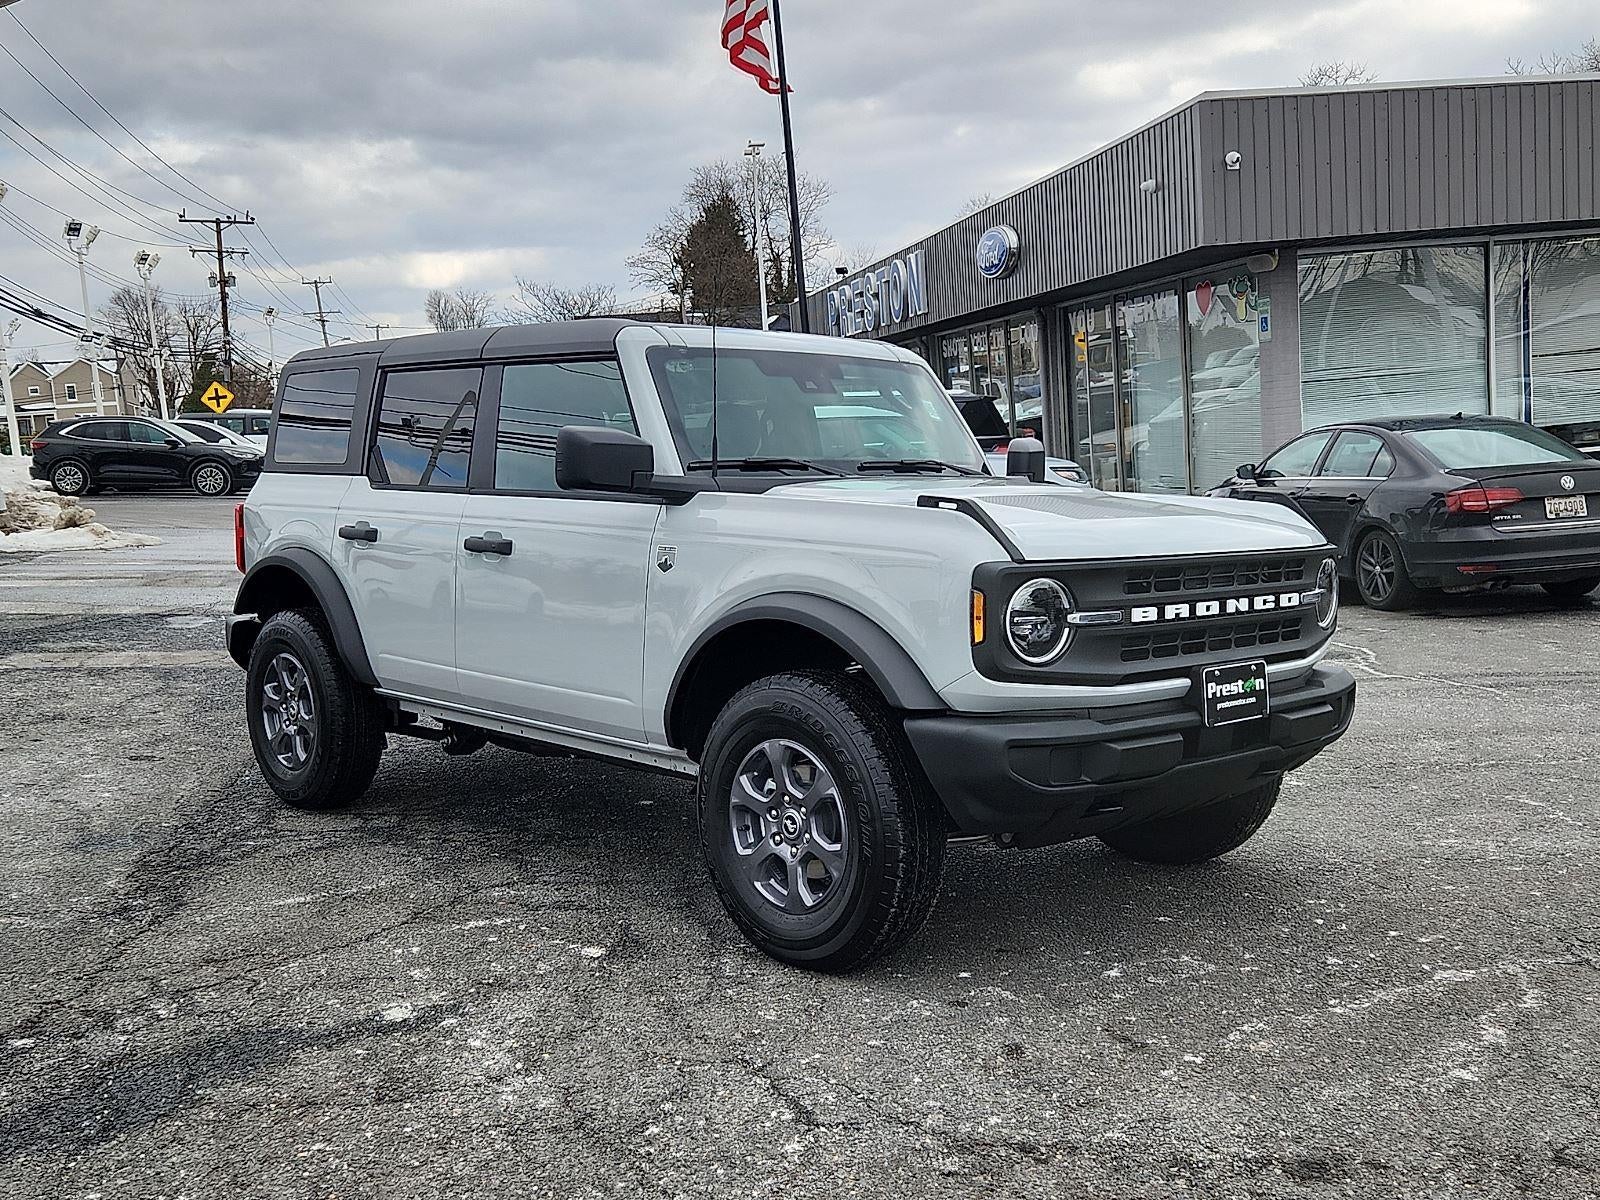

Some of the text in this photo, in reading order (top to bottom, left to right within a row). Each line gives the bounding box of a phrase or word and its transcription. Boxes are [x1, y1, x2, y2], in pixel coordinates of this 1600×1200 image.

[827, 250, 928, 338] PRESTON
[1068, 307, 1095, 335] YOU
[1131, 593, 1300, 623] BRONCO
